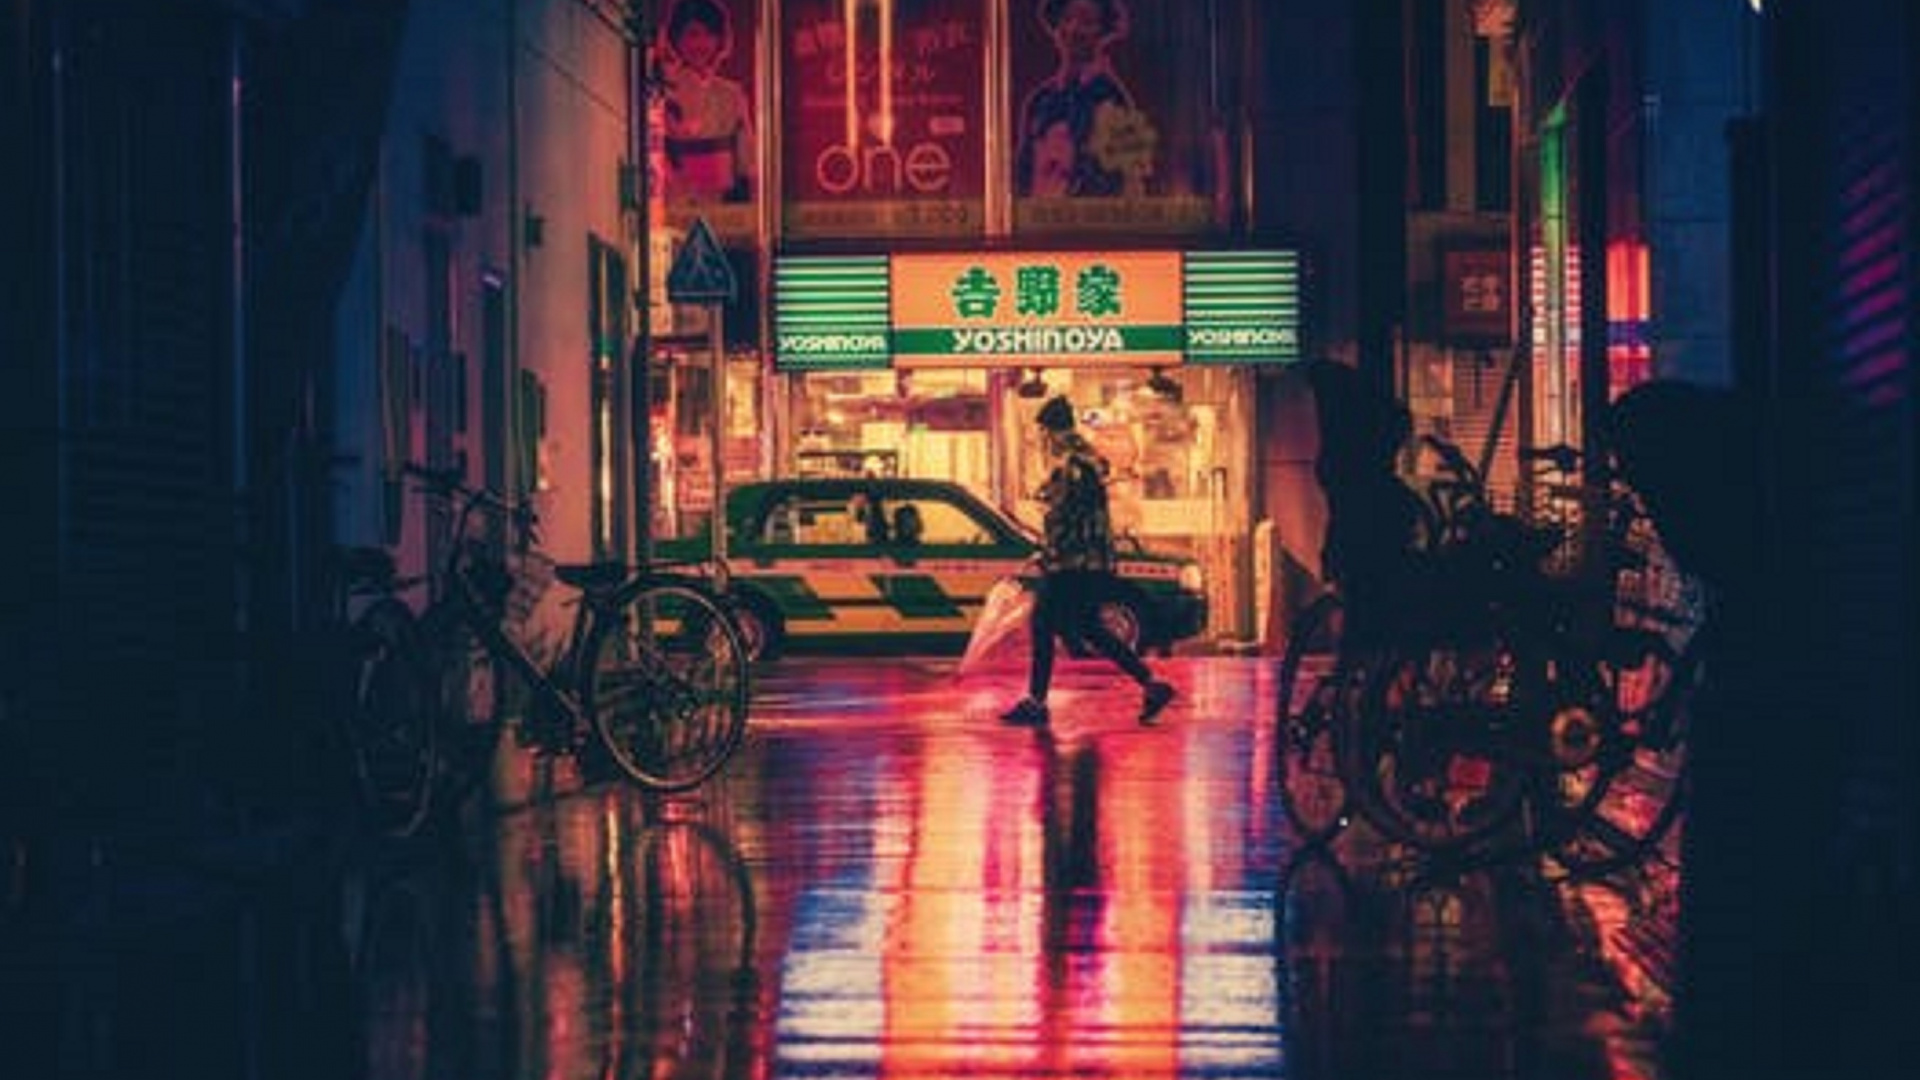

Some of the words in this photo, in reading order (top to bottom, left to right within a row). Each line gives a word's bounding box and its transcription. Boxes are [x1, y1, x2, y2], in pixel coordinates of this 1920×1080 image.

[816, 141, 951, 194] one
[952, 264, 1122, 319] 吉野家
